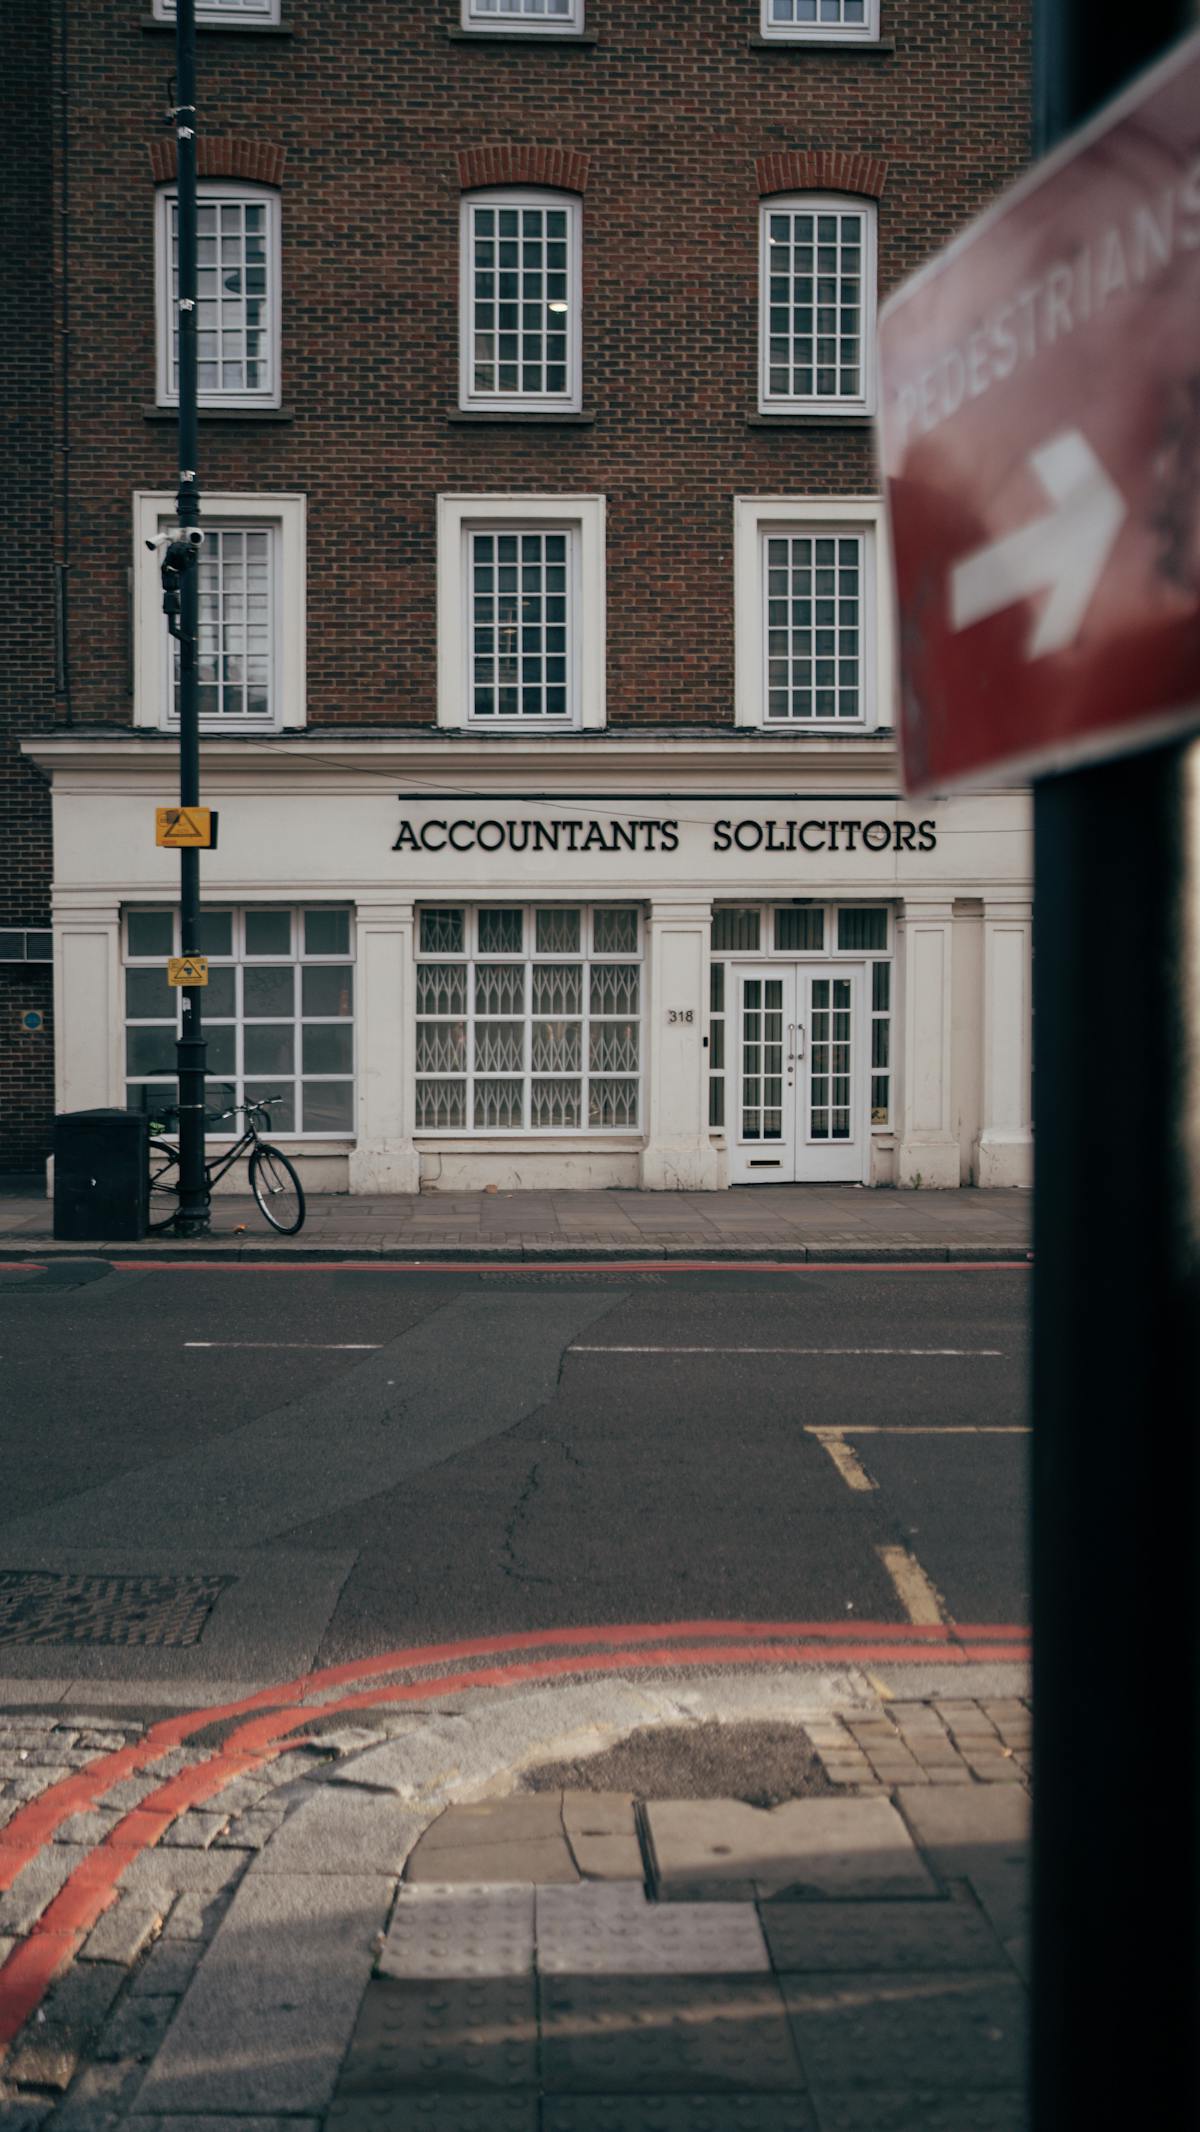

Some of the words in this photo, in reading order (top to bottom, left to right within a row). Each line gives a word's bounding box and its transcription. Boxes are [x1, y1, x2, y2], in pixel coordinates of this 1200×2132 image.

[392, 820, 679, 851] ACCOUNTANTS
[714, 820, 936, 851] SOLICITORS
[669, 1010, 693, 1023] 318
